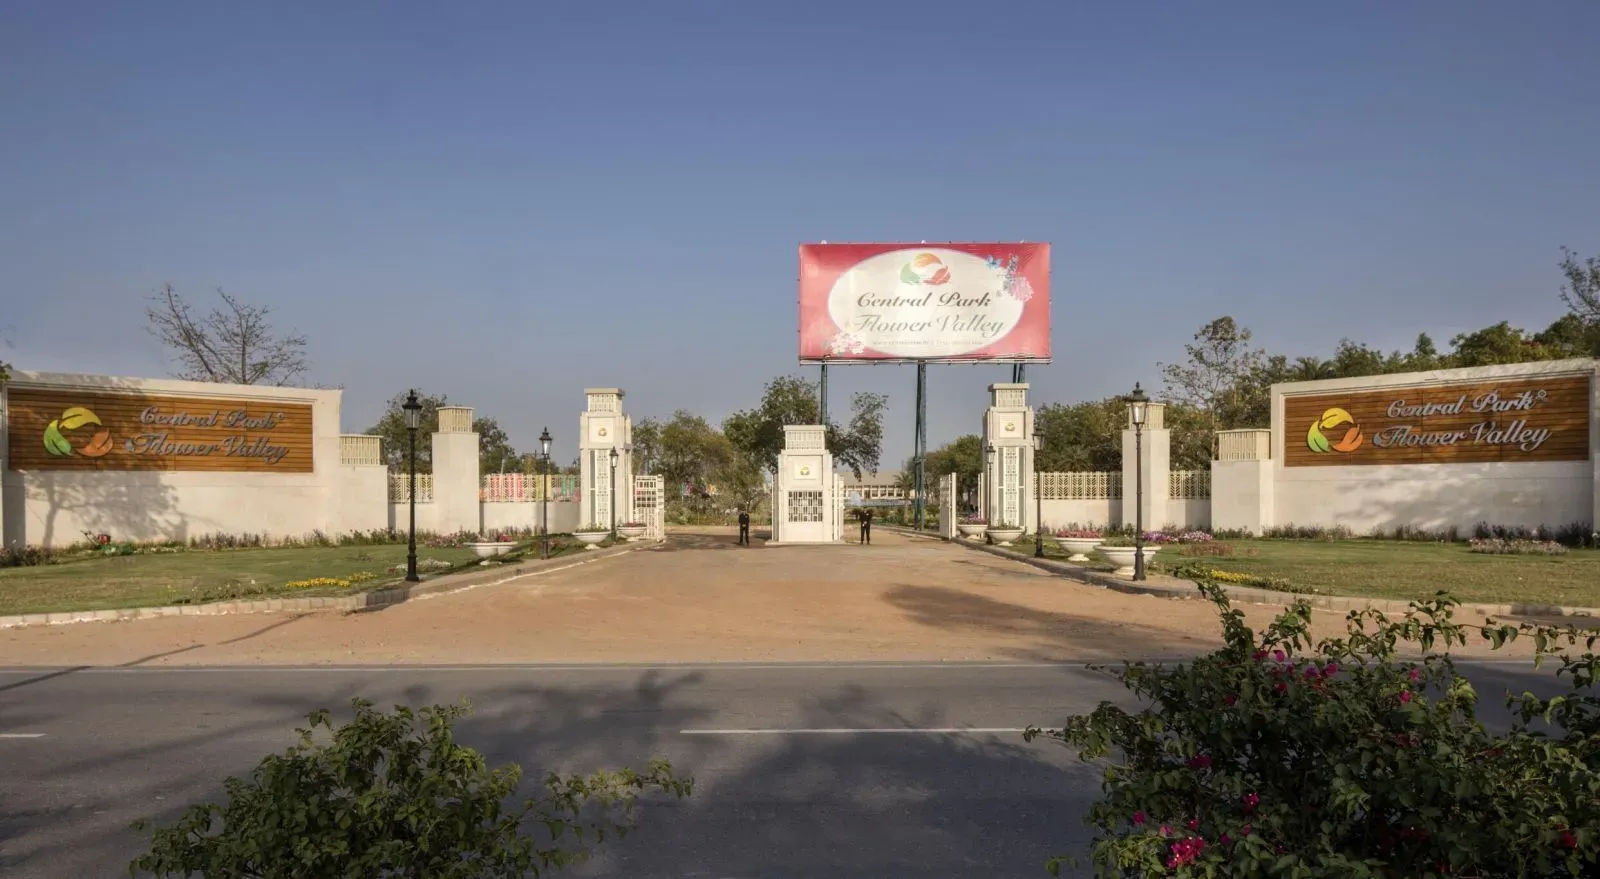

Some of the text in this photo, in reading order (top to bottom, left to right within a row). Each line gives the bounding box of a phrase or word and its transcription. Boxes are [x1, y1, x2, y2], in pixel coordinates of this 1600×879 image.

[857, 292, 992, 307] Central Park
[853, 314, 1004, 338] Flower Valley
[140, 406, 219, 427] Central
[1387, 395, 1467, 418] Central
[1375, 419, 1552, 452] Flower Valley
[132, 433, 290, 465] Flower Valley
